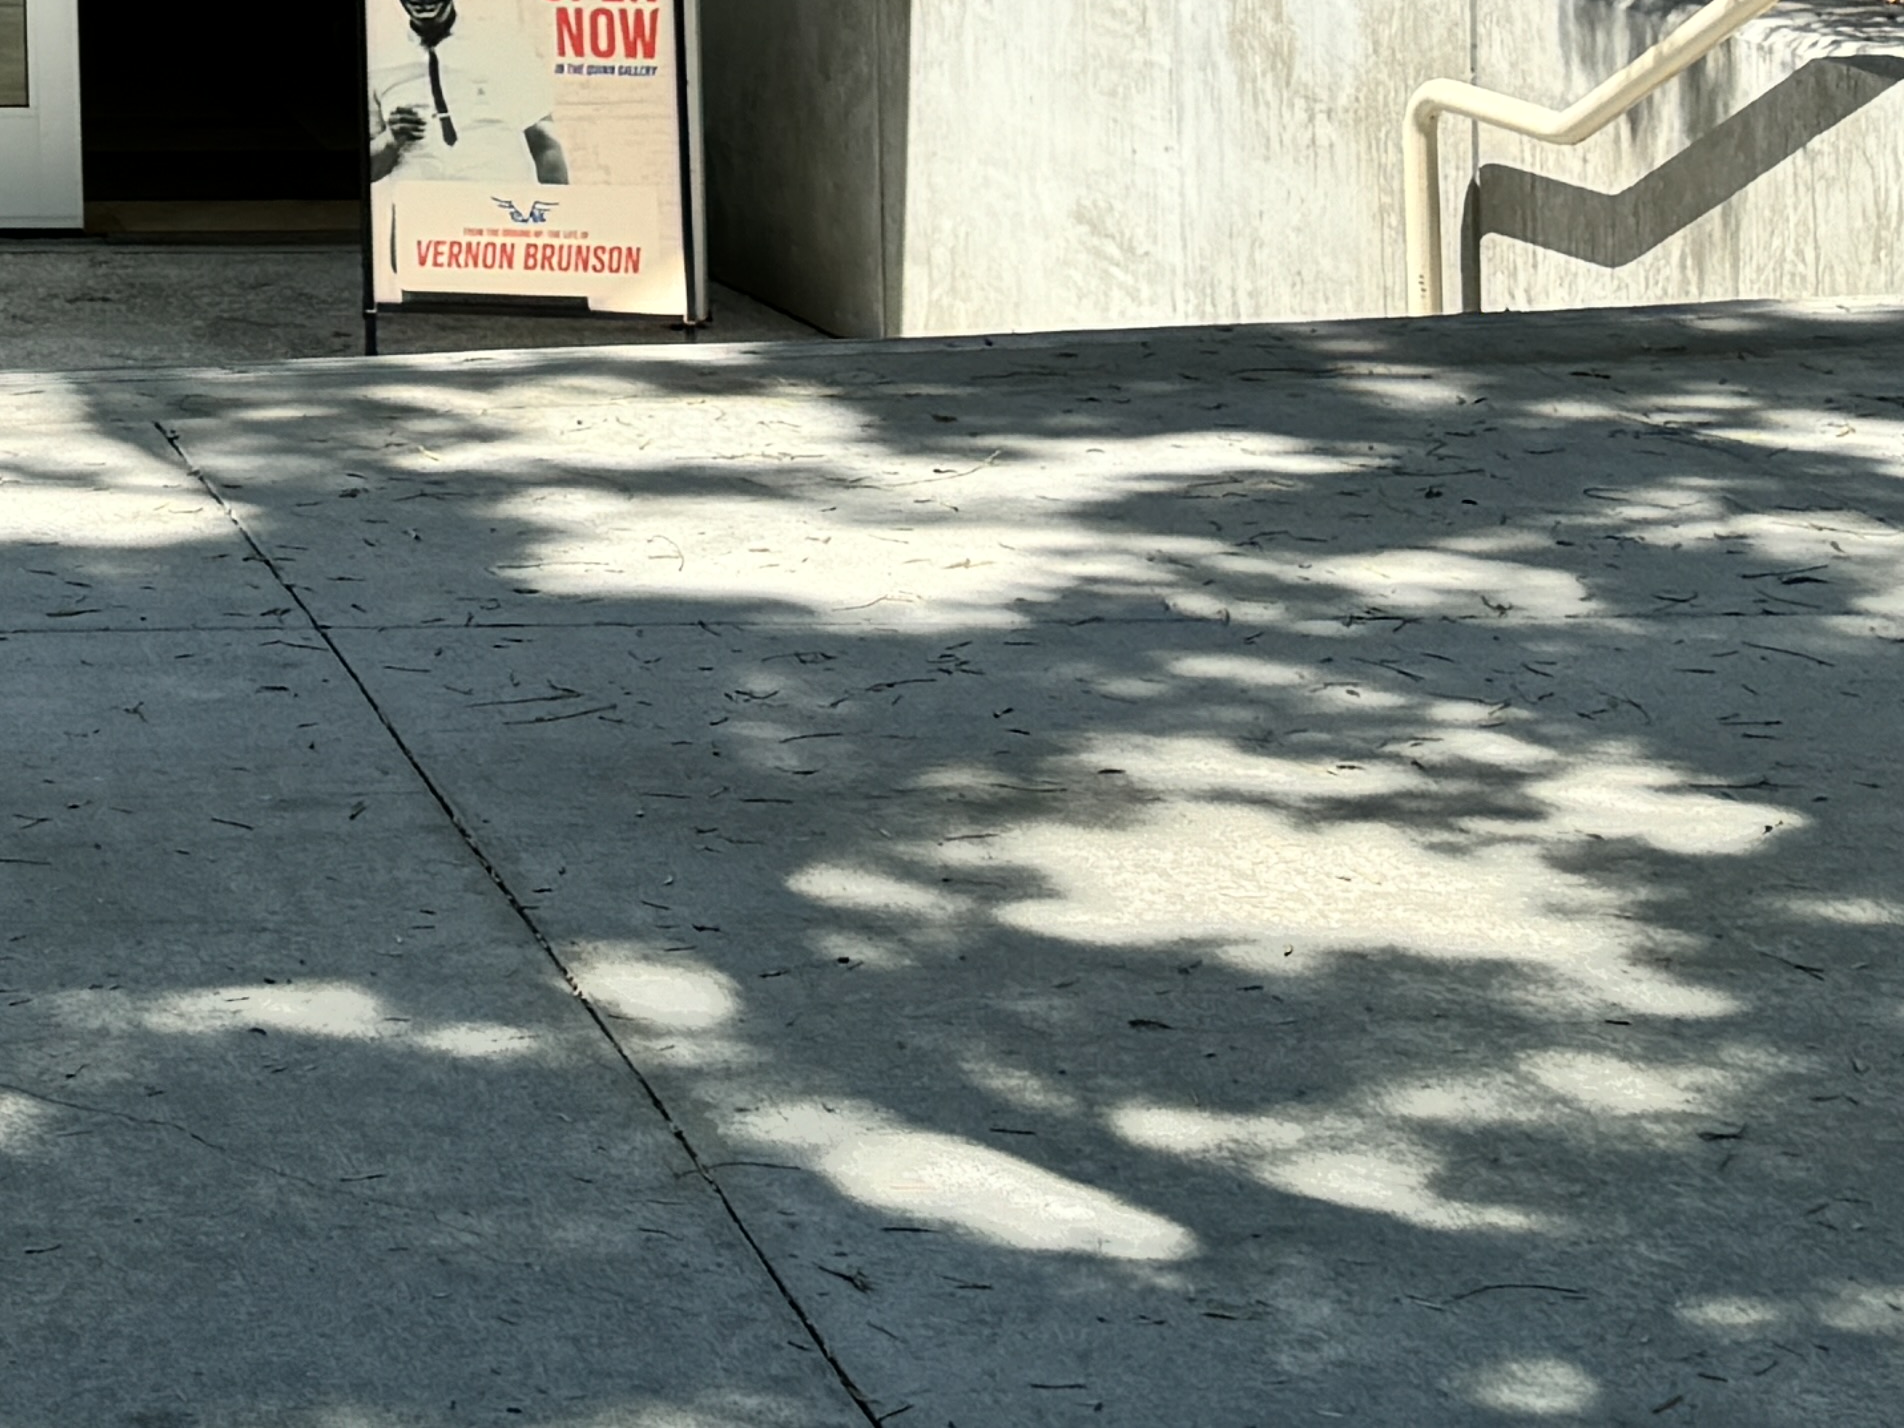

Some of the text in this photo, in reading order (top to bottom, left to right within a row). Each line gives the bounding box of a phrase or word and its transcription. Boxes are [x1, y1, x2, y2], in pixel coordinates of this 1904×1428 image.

[555, 6, 661, 59] NOW
[417, 240, 642, 275] VERNON BRUNSON
